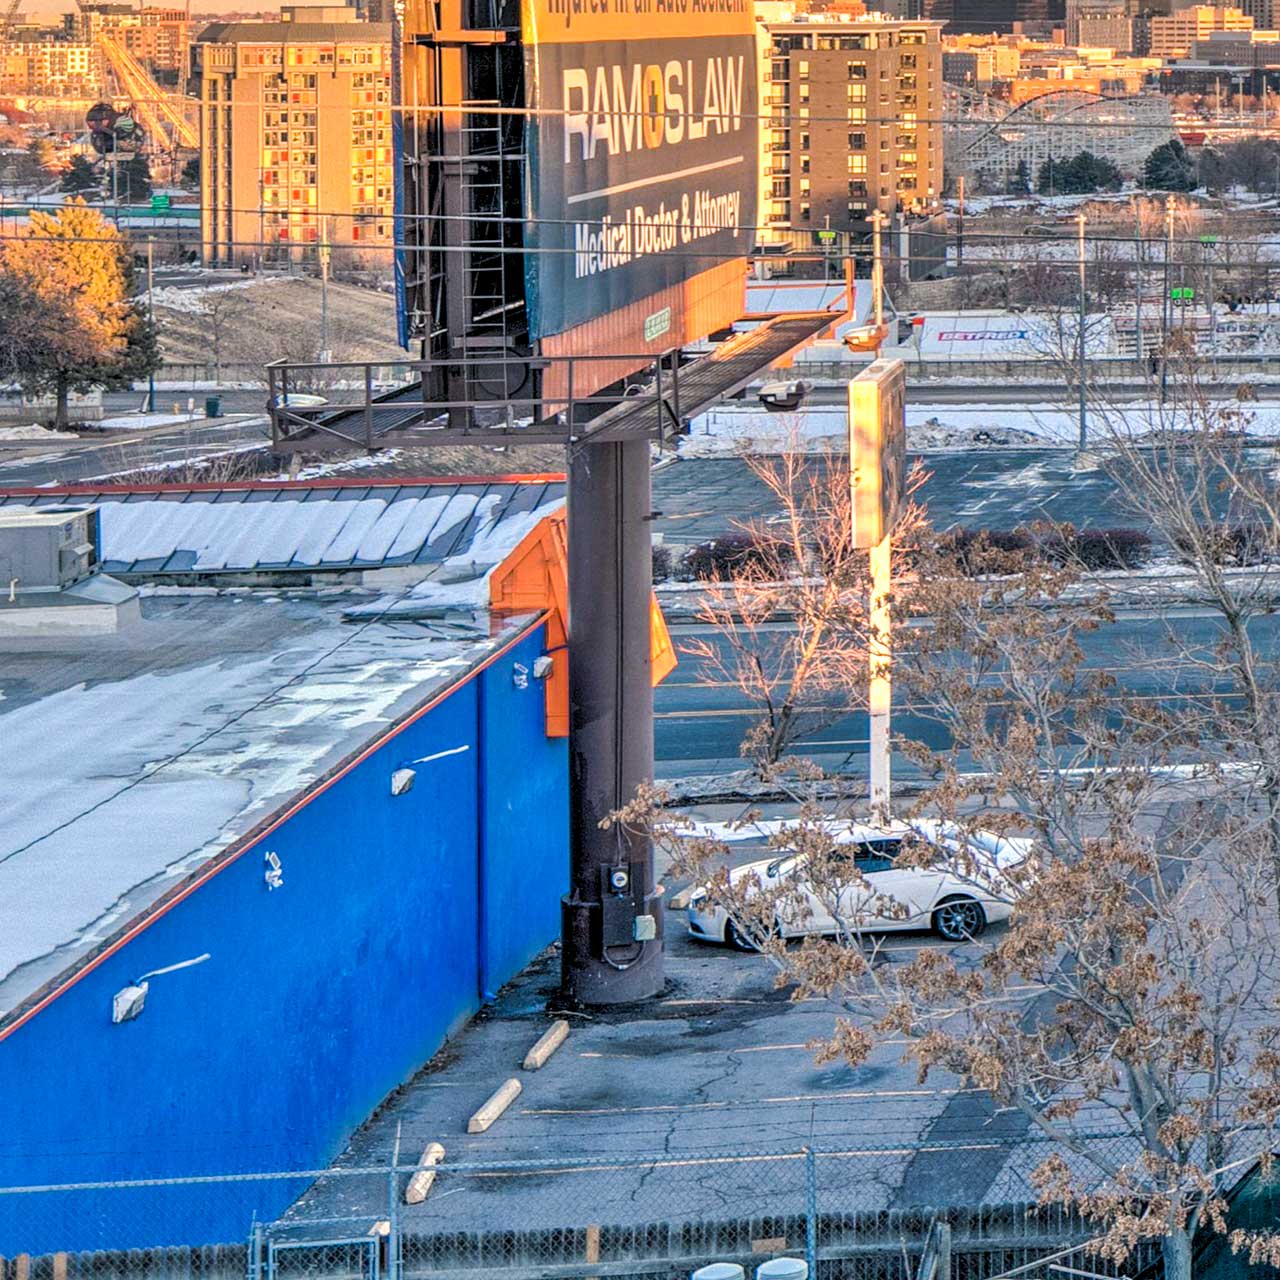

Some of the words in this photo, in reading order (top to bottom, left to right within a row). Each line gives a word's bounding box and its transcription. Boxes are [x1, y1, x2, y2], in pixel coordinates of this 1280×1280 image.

[575, 209, 631, 279] Medical
[635, 201, 679, 258] Doctor
[681, 193, 691, 244] &
[693, 191, 740, 239] Attorney
[941, 331, 1020, 341] BETFRED
